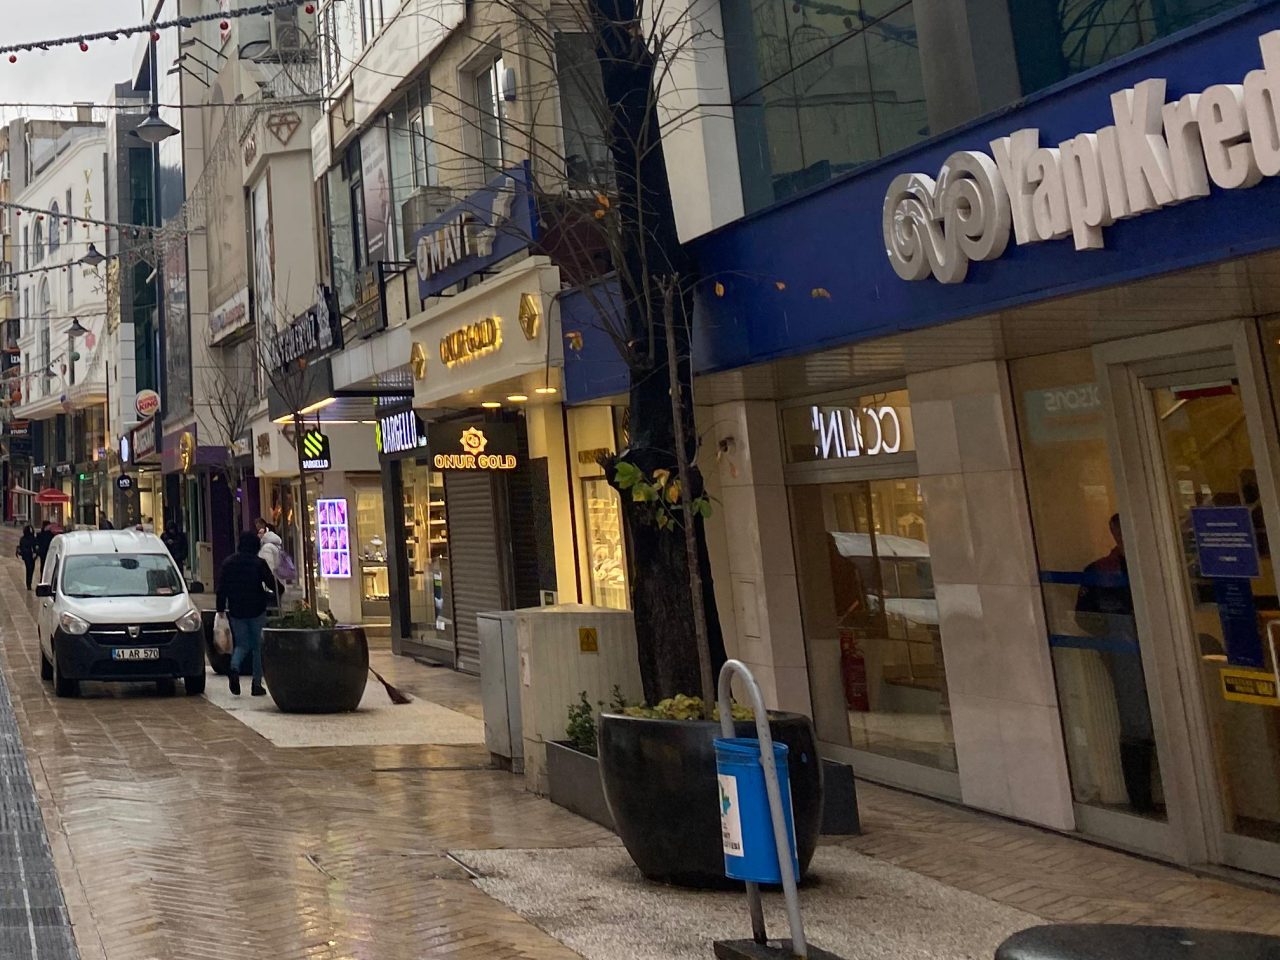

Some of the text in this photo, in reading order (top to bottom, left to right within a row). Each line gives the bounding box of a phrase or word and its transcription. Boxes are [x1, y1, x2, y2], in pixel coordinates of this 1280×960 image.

[381, 410, 417, 454] BARGELLO
[434, 455, 516, 469] ONUR GOLD
[129, 649, 140, 658] AR
